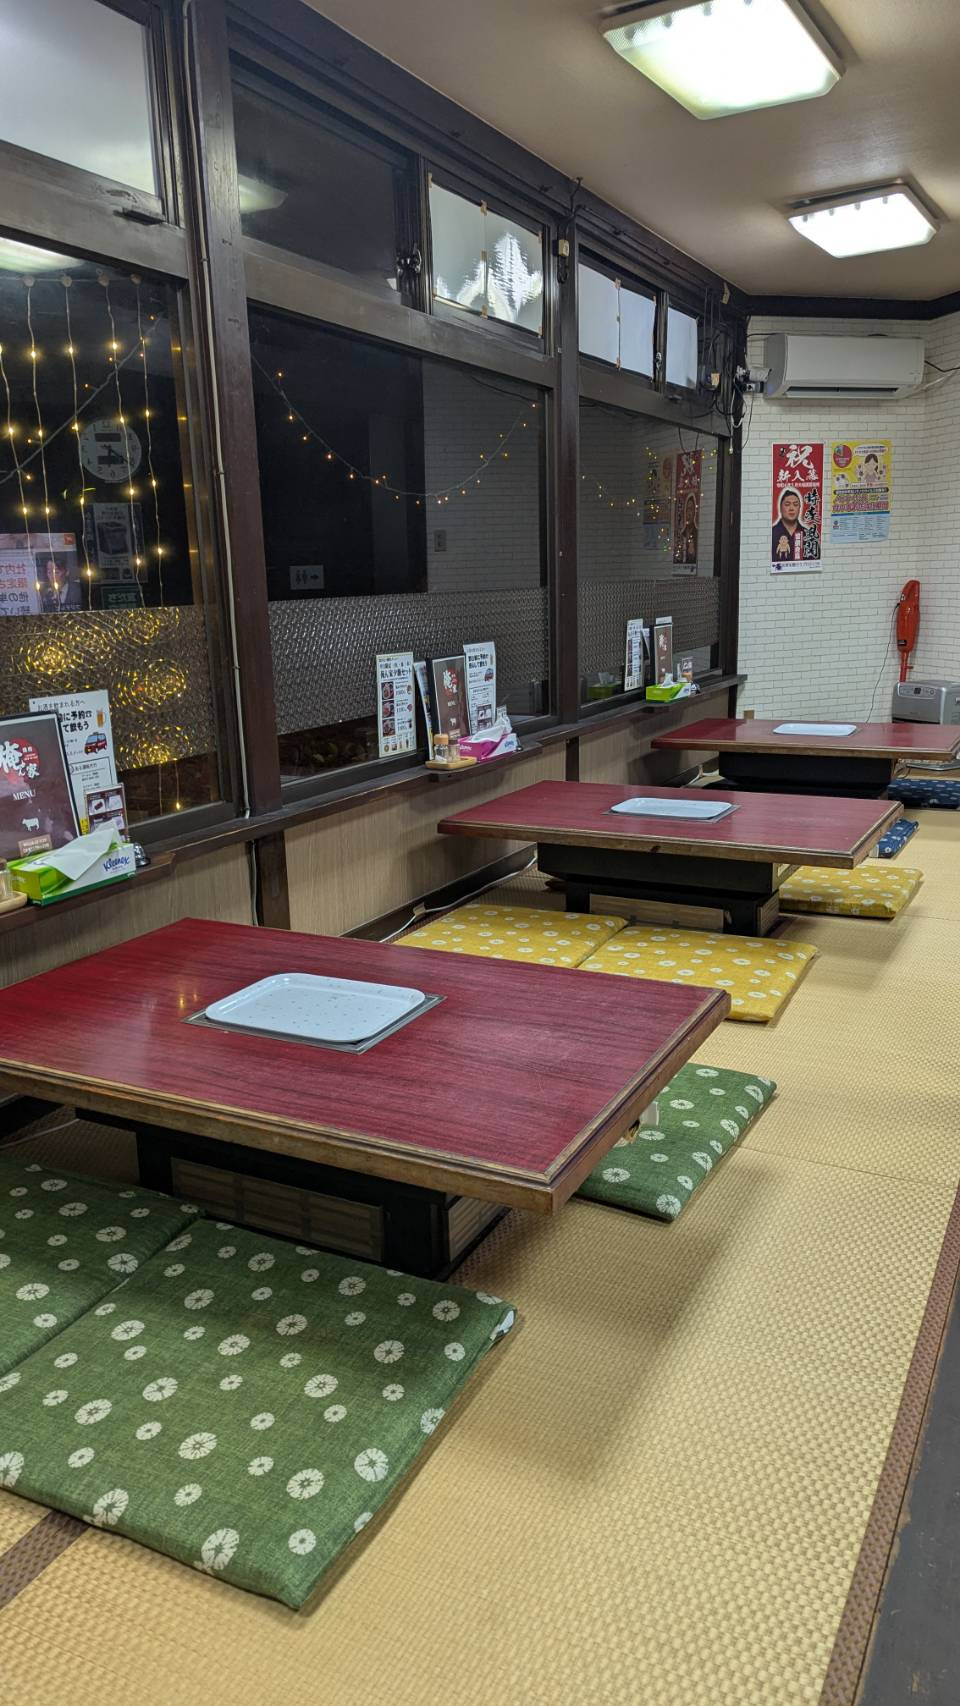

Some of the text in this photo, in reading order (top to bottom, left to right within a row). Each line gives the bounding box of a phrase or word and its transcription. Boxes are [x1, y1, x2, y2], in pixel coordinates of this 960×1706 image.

[785, 444, 814, 469] 祝
[12, 789, 36, 801] MENU
[103, 855, 130, 872] Kleenex
